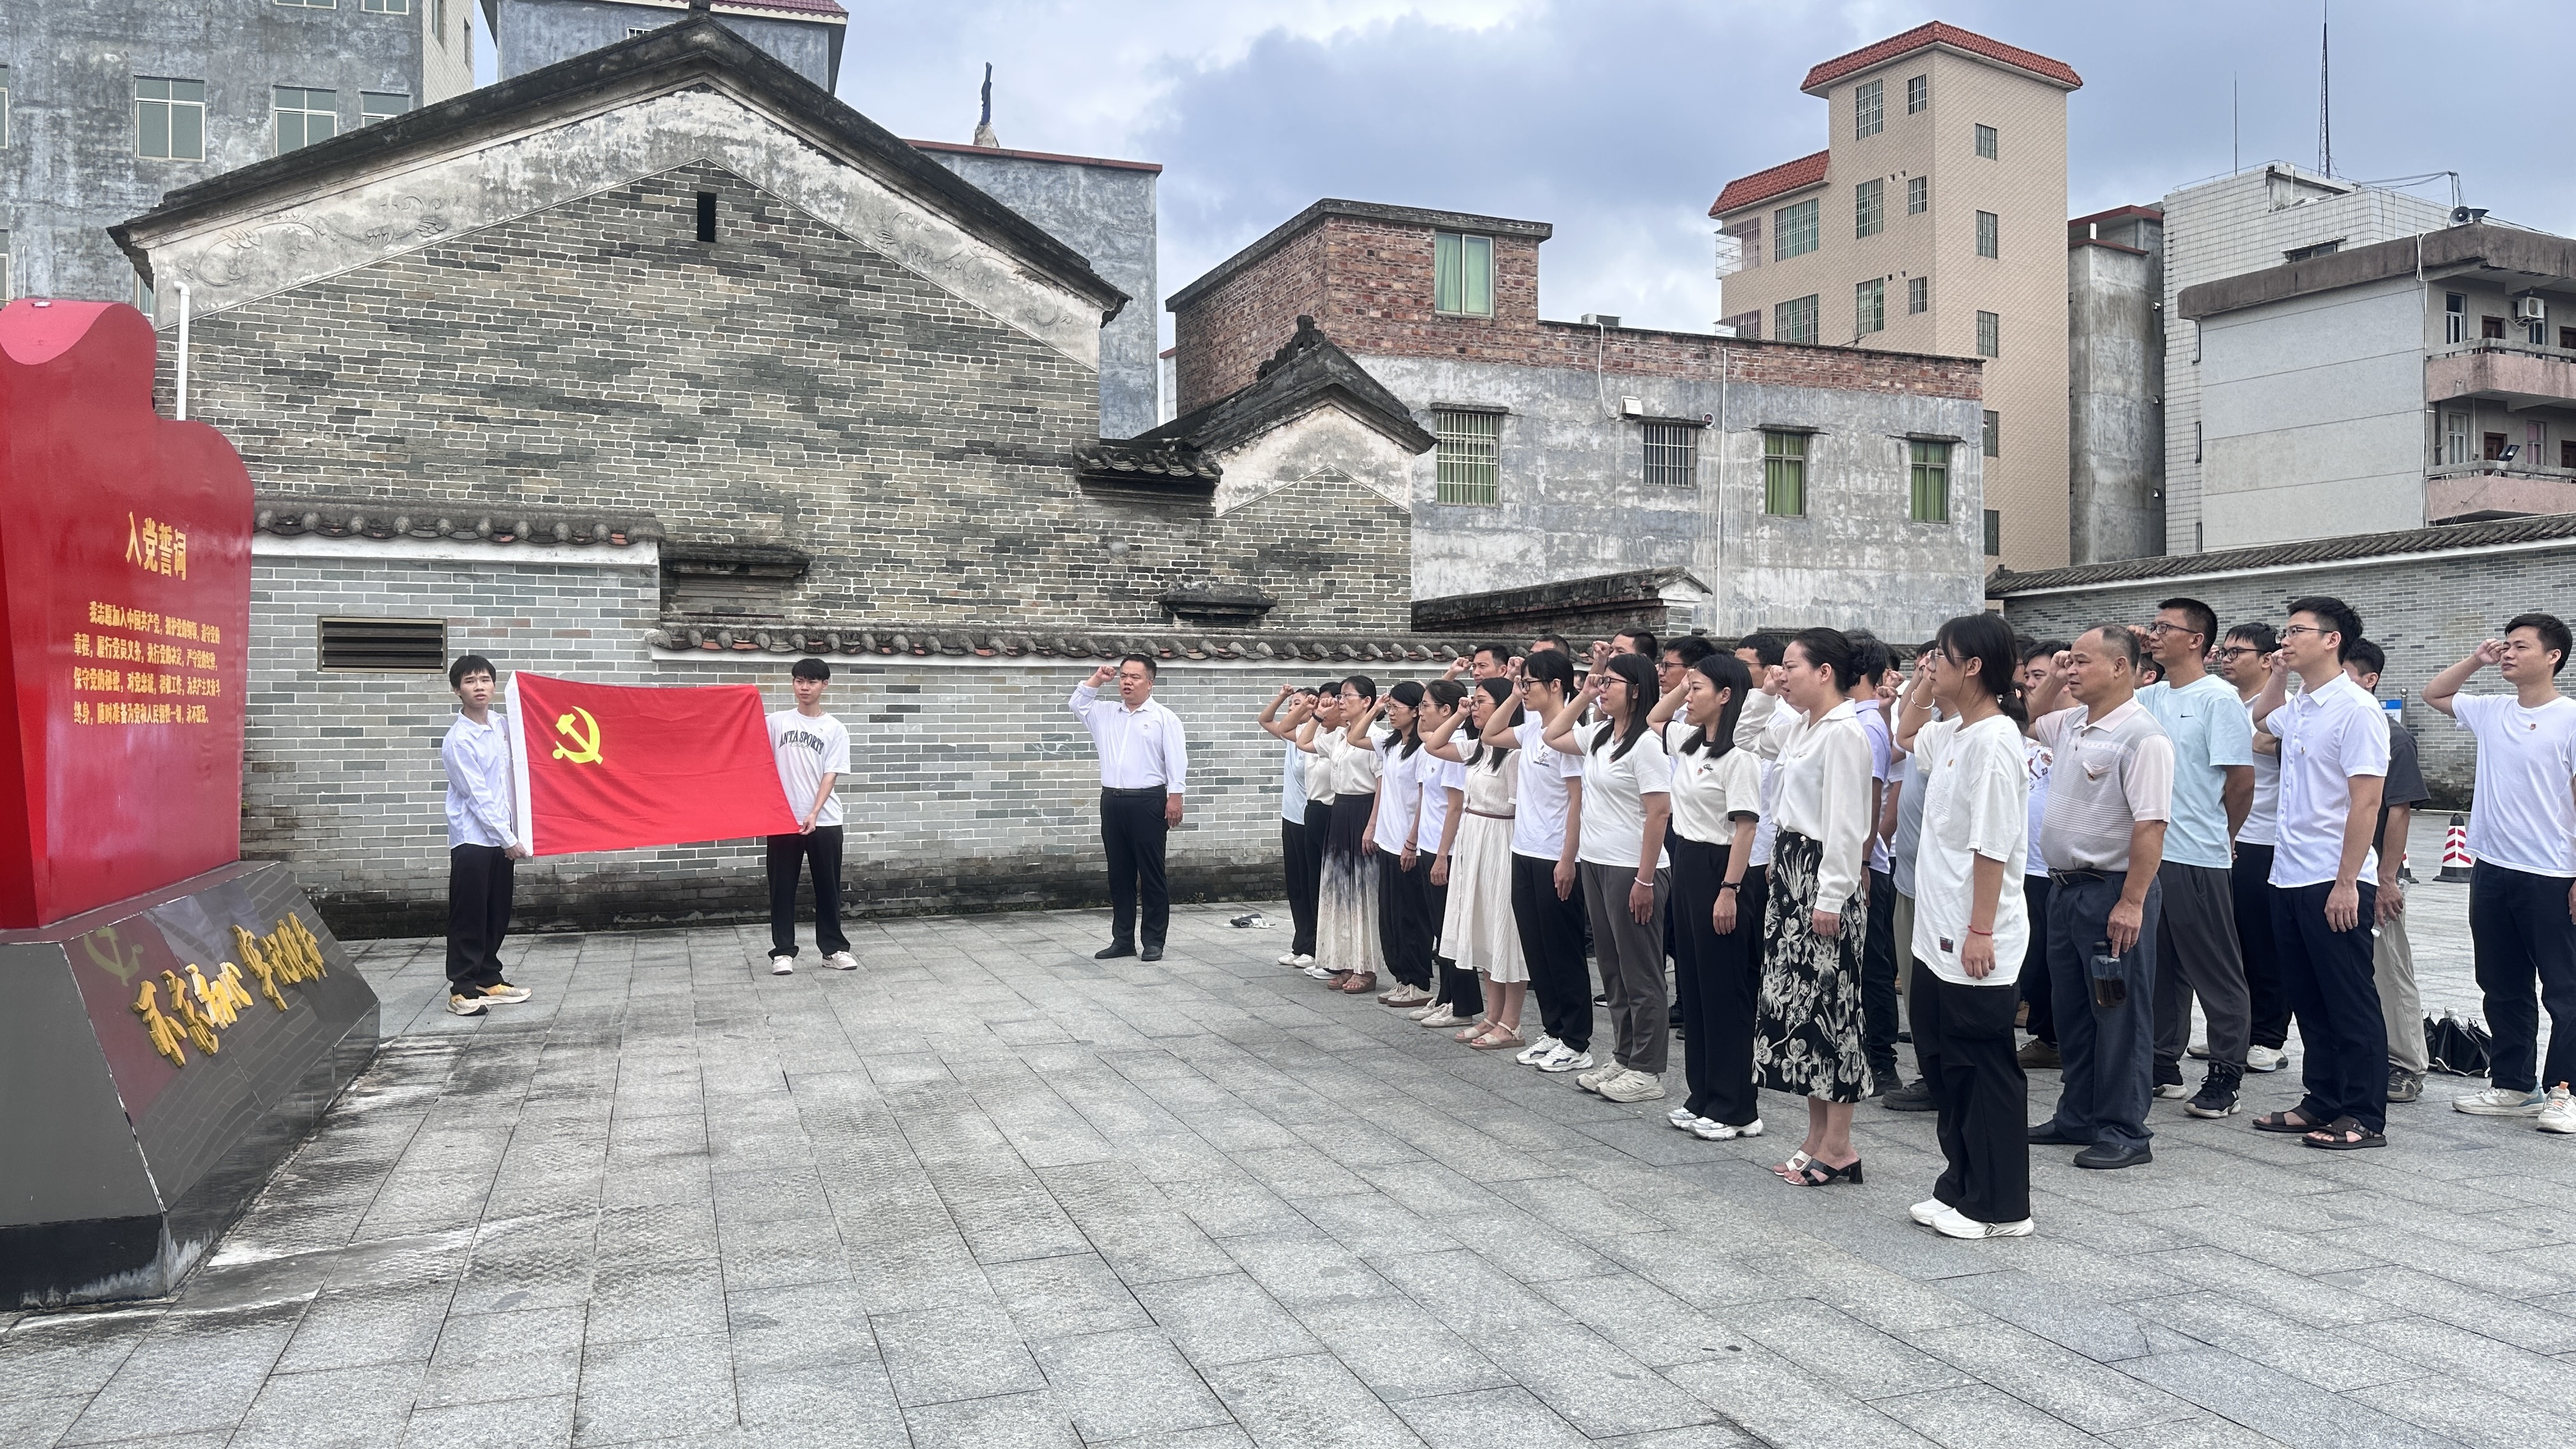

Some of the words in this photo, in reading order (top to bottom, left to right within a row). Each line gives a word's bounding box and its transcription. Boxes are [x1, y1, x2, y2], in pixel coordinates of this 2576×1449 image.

[125, 512, 187, 580] 入党誓词
[779, 730, 798, 748] ANTA
[799, 731, 824, 755] SPORTS
[130, 963, 254, 1068] 不忘初心
[231, 912, 328, 1011] 牢记使命
